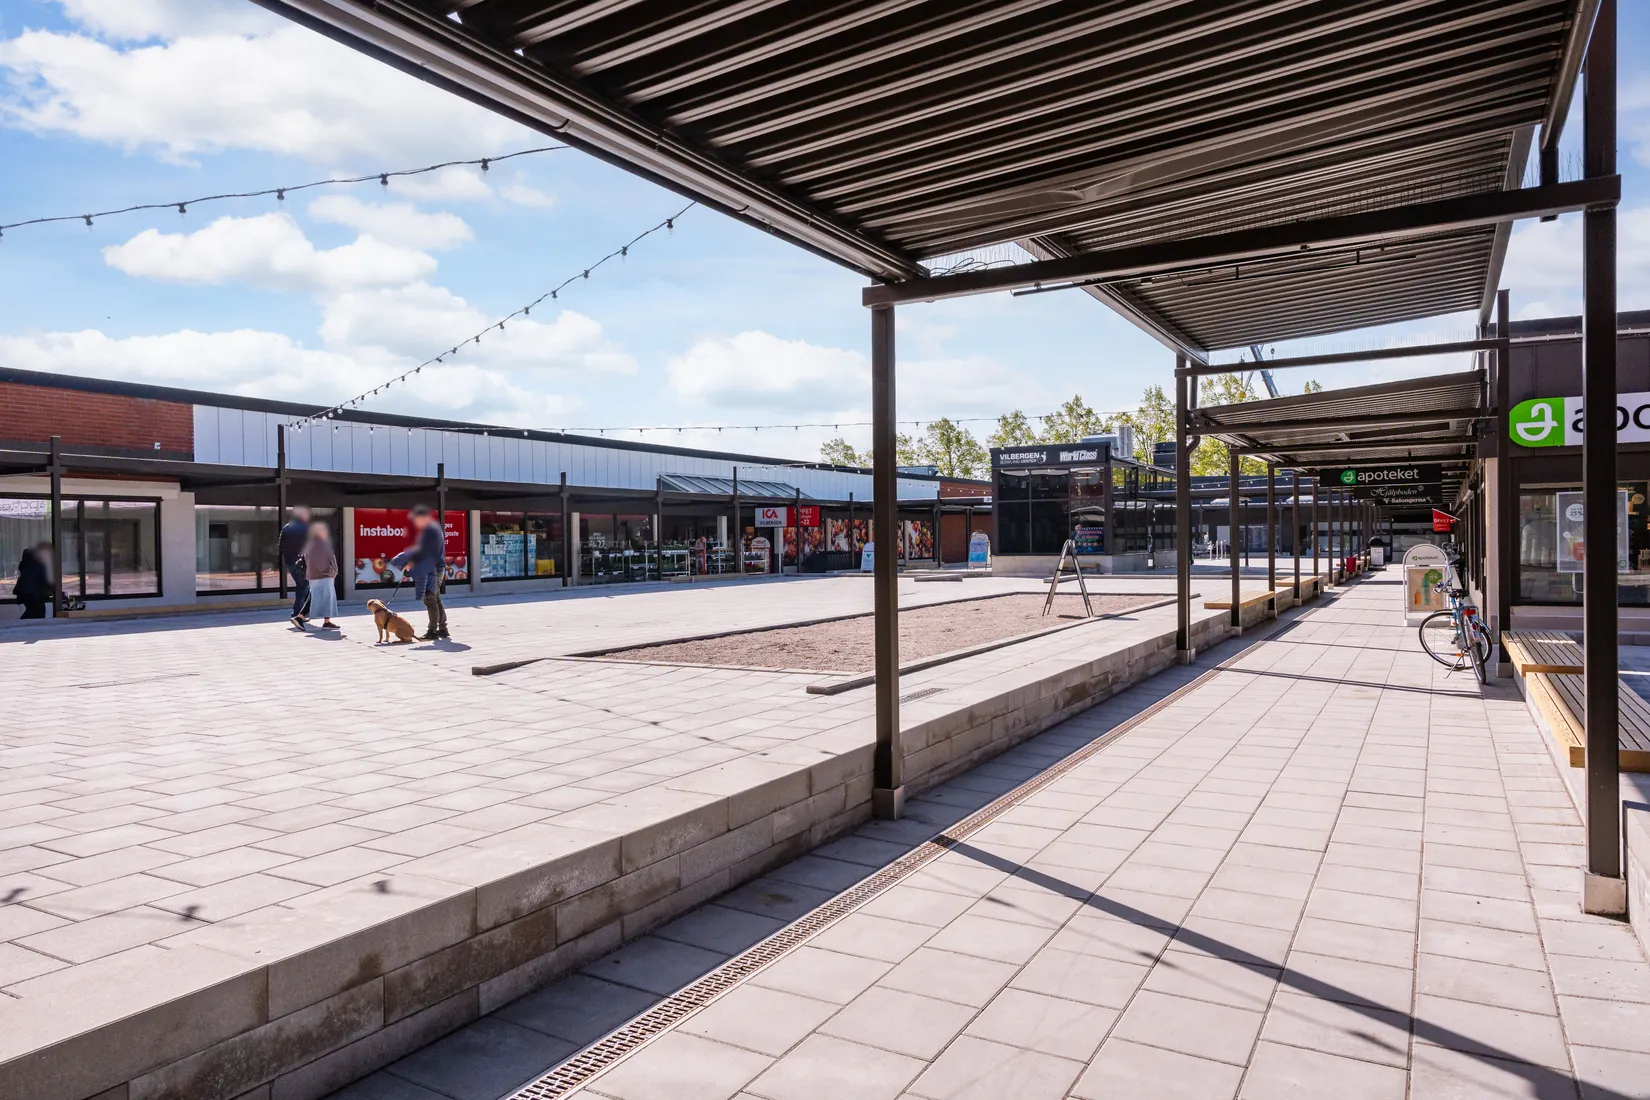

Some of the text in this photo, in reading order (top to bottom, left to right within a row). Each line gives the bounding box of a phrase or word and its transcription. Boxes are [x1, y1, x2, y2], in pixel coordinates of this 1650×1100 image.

[1000, 452, 1039, 460] VILBERGEN
[1060, 449, 1097, 462] World Class
[1357, 468, 1420, 483] apoteket
[762, 509, 778, 519] ICA
